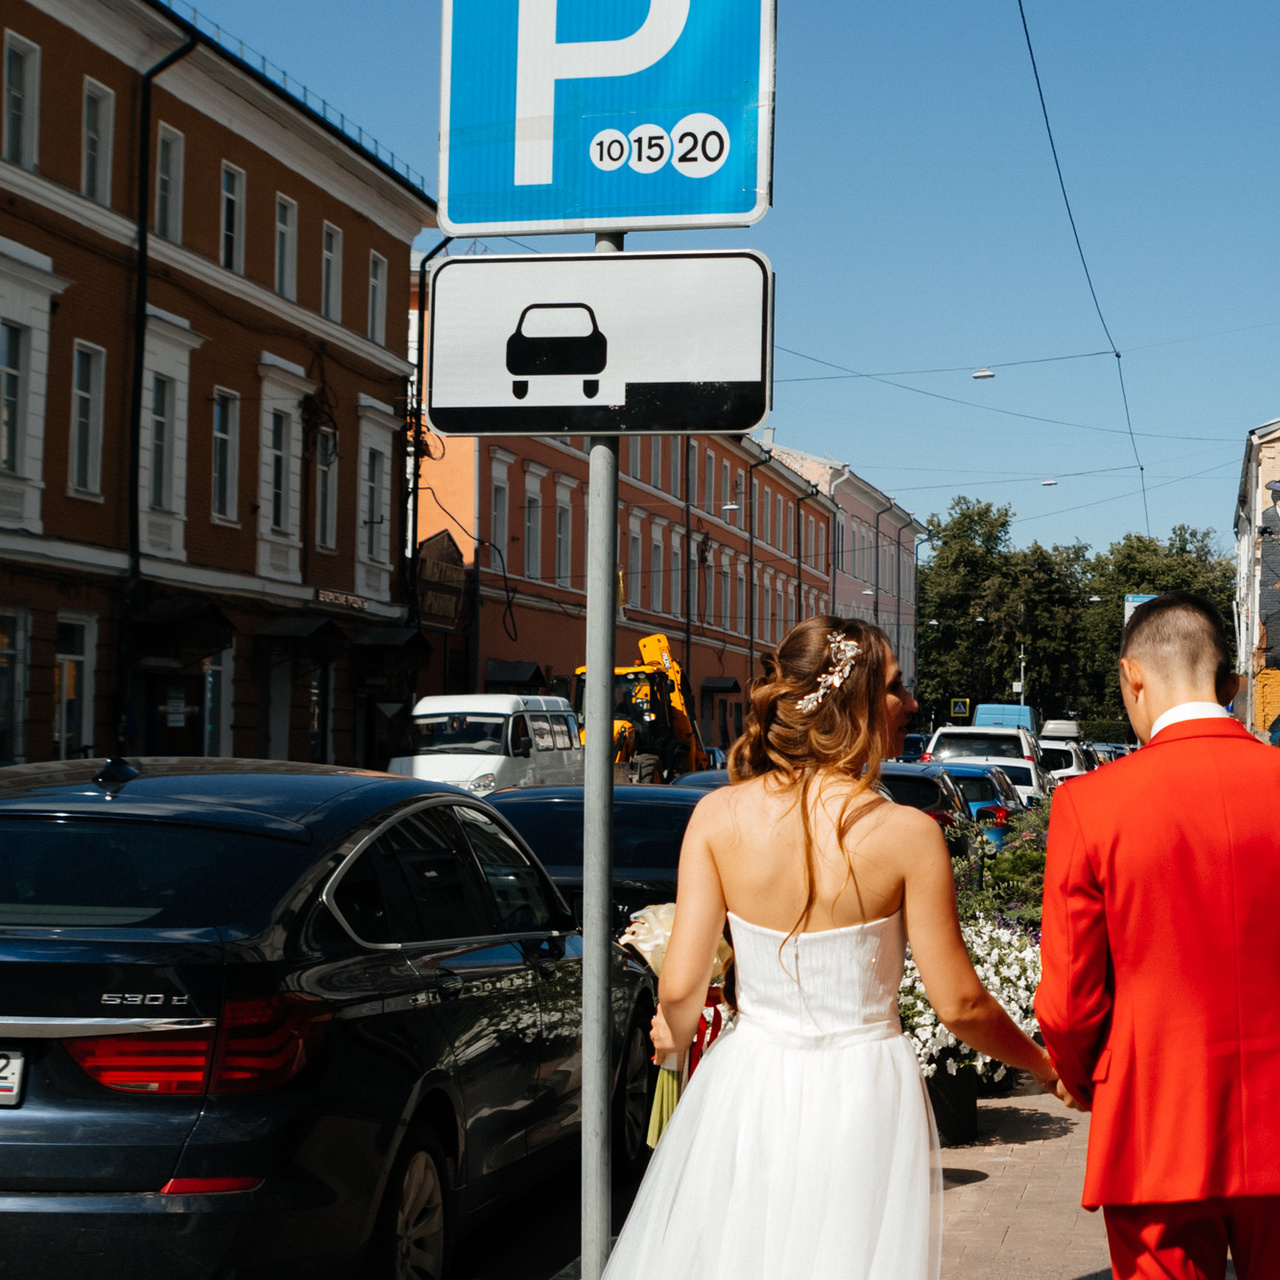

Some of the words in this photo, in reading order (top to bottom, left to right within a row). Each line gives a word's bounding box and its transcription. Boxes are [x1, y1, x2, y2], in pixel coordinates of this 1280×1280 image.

[596, 139, 625, 162] 10
[633, 135, 664, 163] 15
[677, 130, 725, 163] 20
